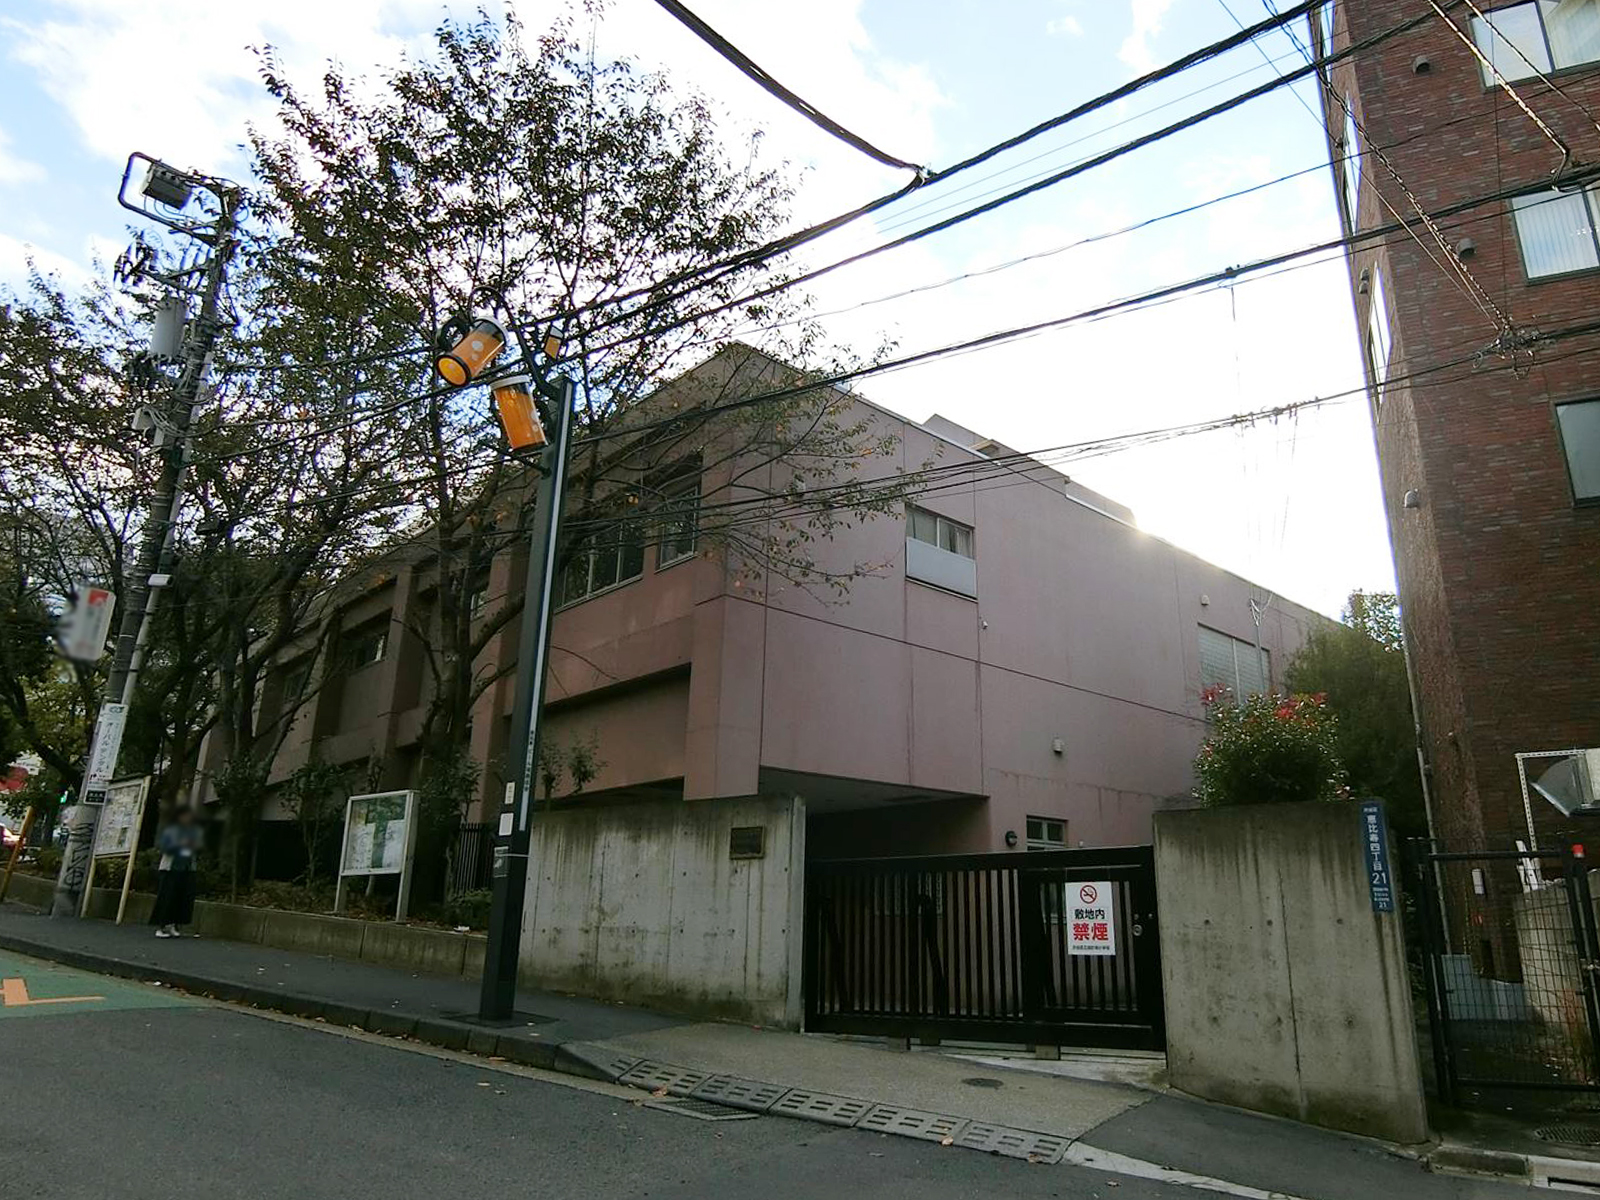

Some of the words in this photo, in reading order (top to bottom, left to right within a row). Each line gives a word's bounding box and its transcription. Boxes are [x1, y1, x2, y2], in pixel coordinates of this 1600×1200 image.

[1367, 815, 1382, 870] 恵比寿四丁目
[1372, 872, 1387, 884] 21
[1074, 908, 1106, 920] 敷地内
[1073, 922, 1108, 941] 禁煙
